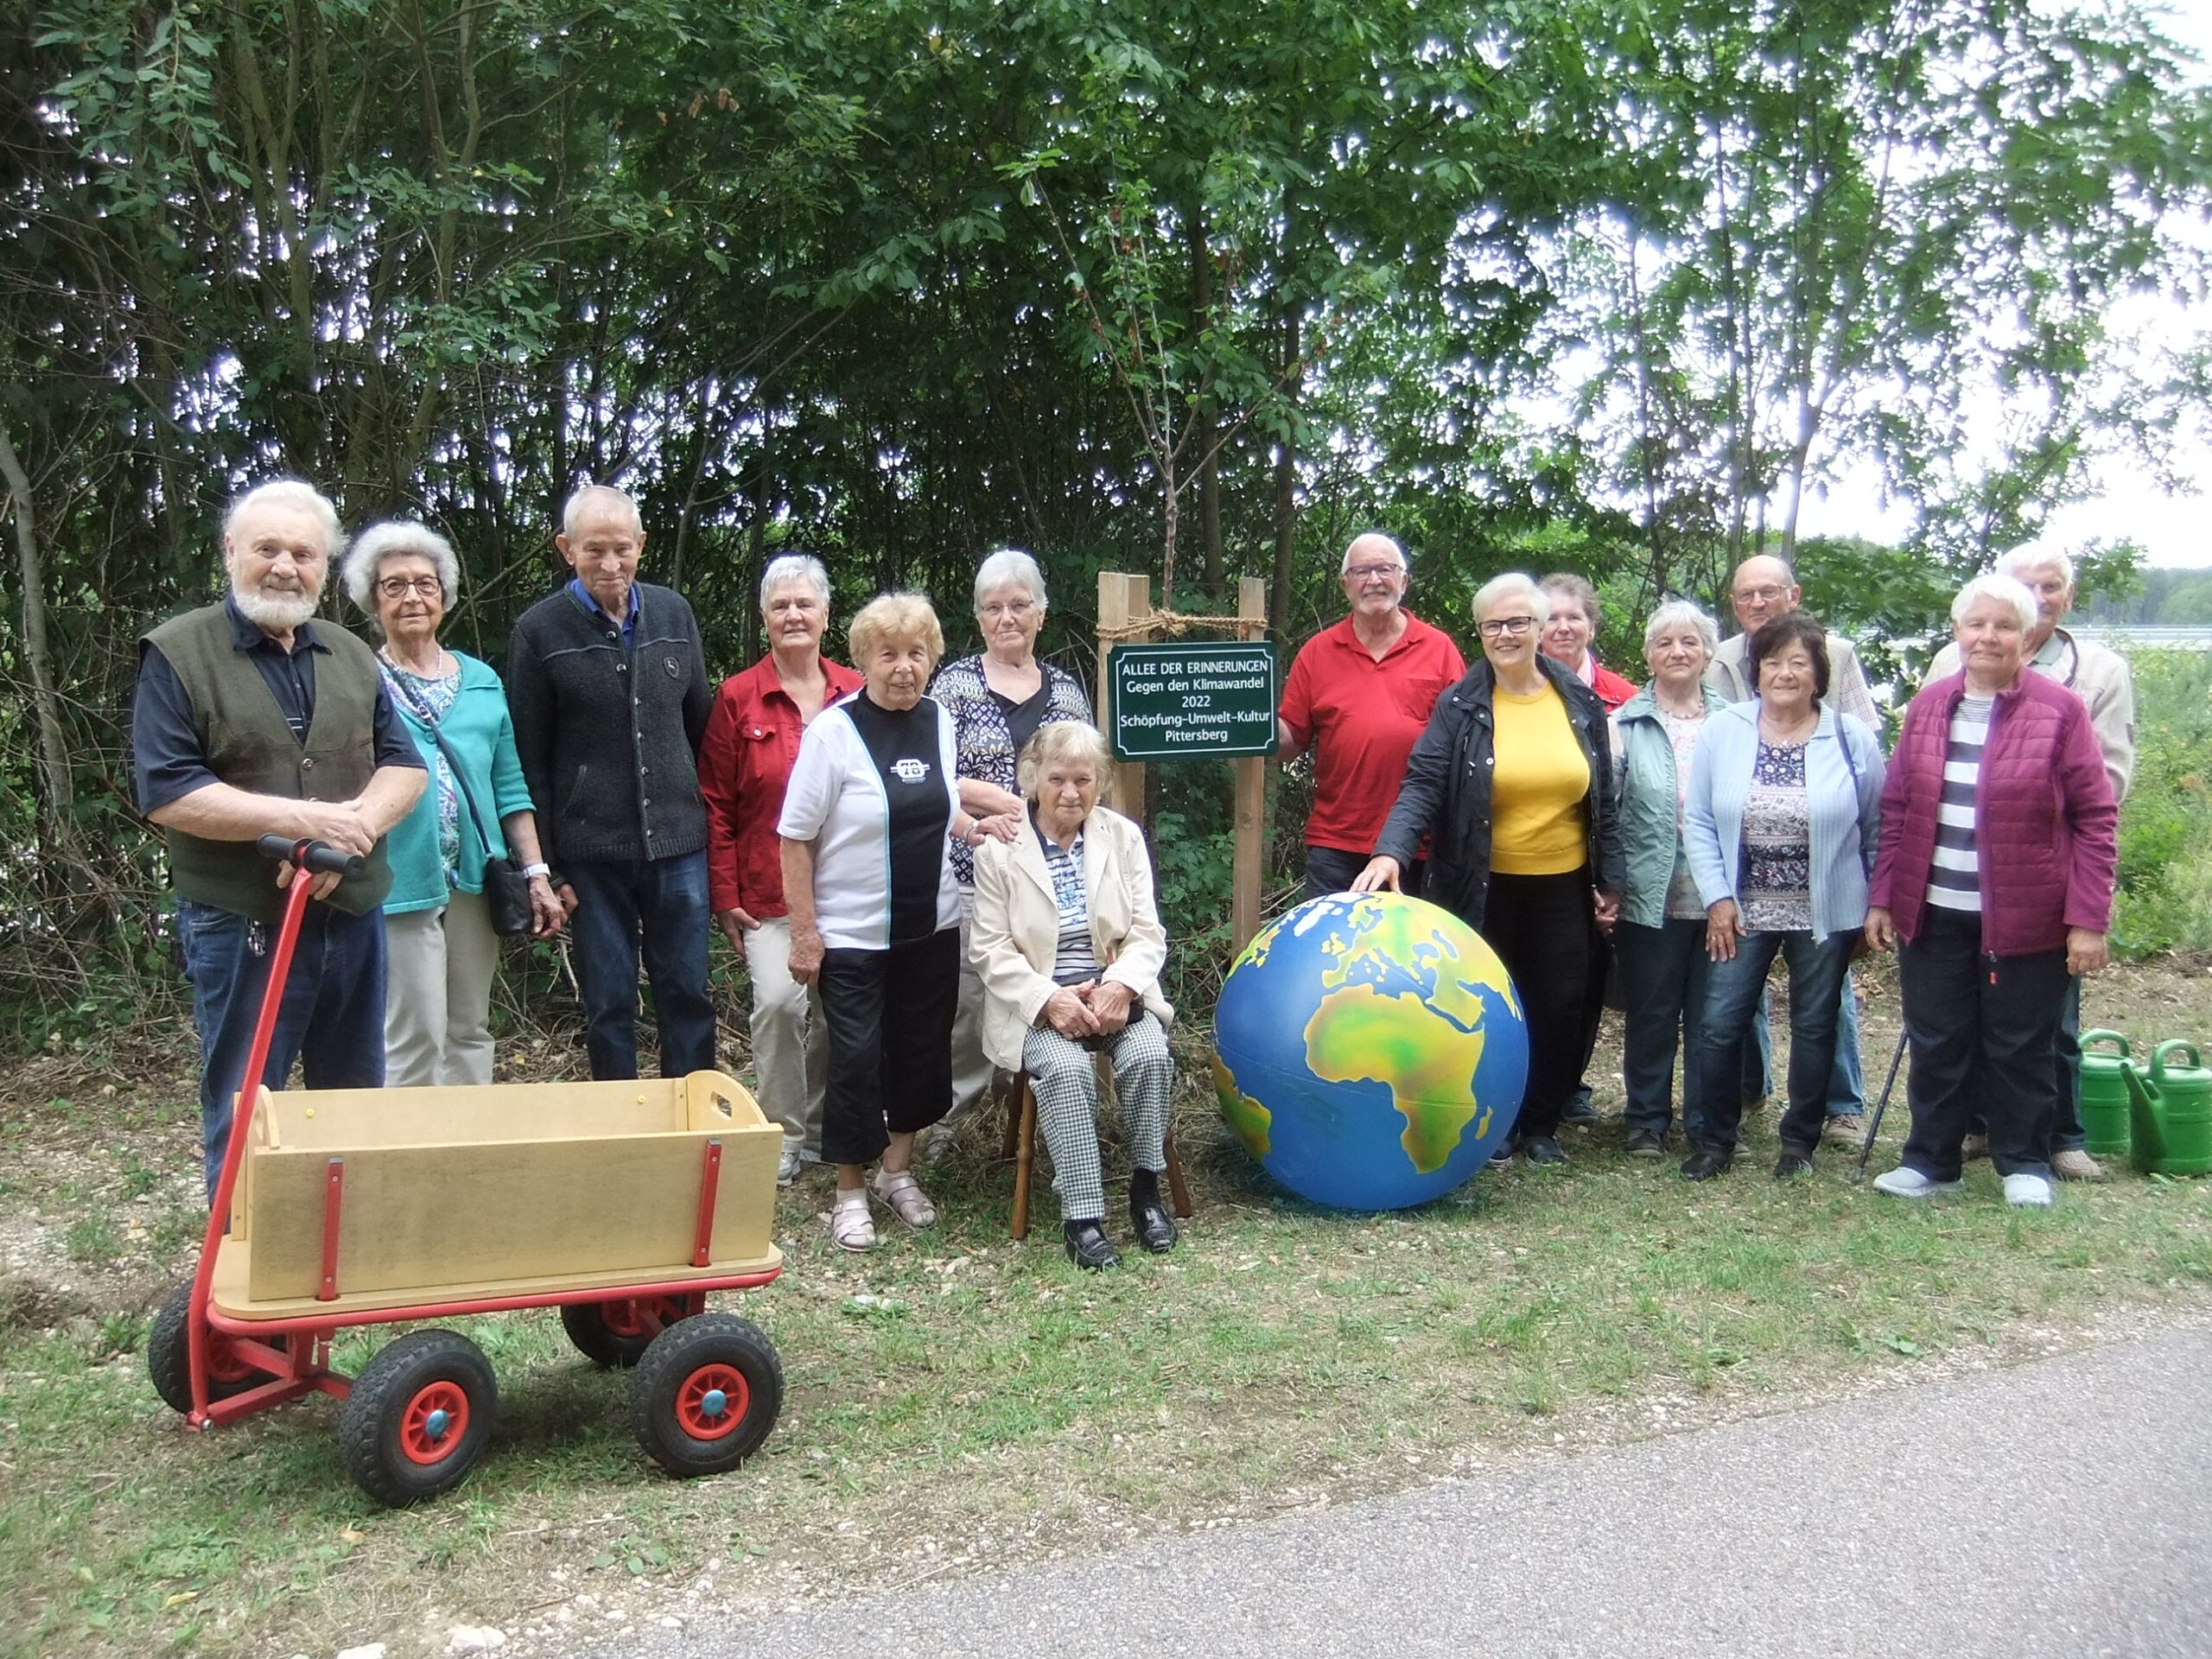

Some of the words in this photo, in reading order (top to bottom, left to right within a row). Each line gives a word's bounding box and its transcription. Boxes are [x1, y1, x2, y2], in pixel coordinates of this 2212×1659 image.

[1122, 664, 1156, 676] ALLEE
[1160, 663, 1182, 675] DER
[1187, 660, 1268, 674] ERINNERUNGEN
[1127, 681, 1163, 695] Gegen
[1167, 679, 1189, 691] den
[1193, 677, 1263, 690] Klimawandel
[1182, 696, 1211, 708] 2022
[1121, 710, 1270, 728] Schöpfung-Umwelt-Kultur
[1165, 728, 1228, 742] Pittersberg
